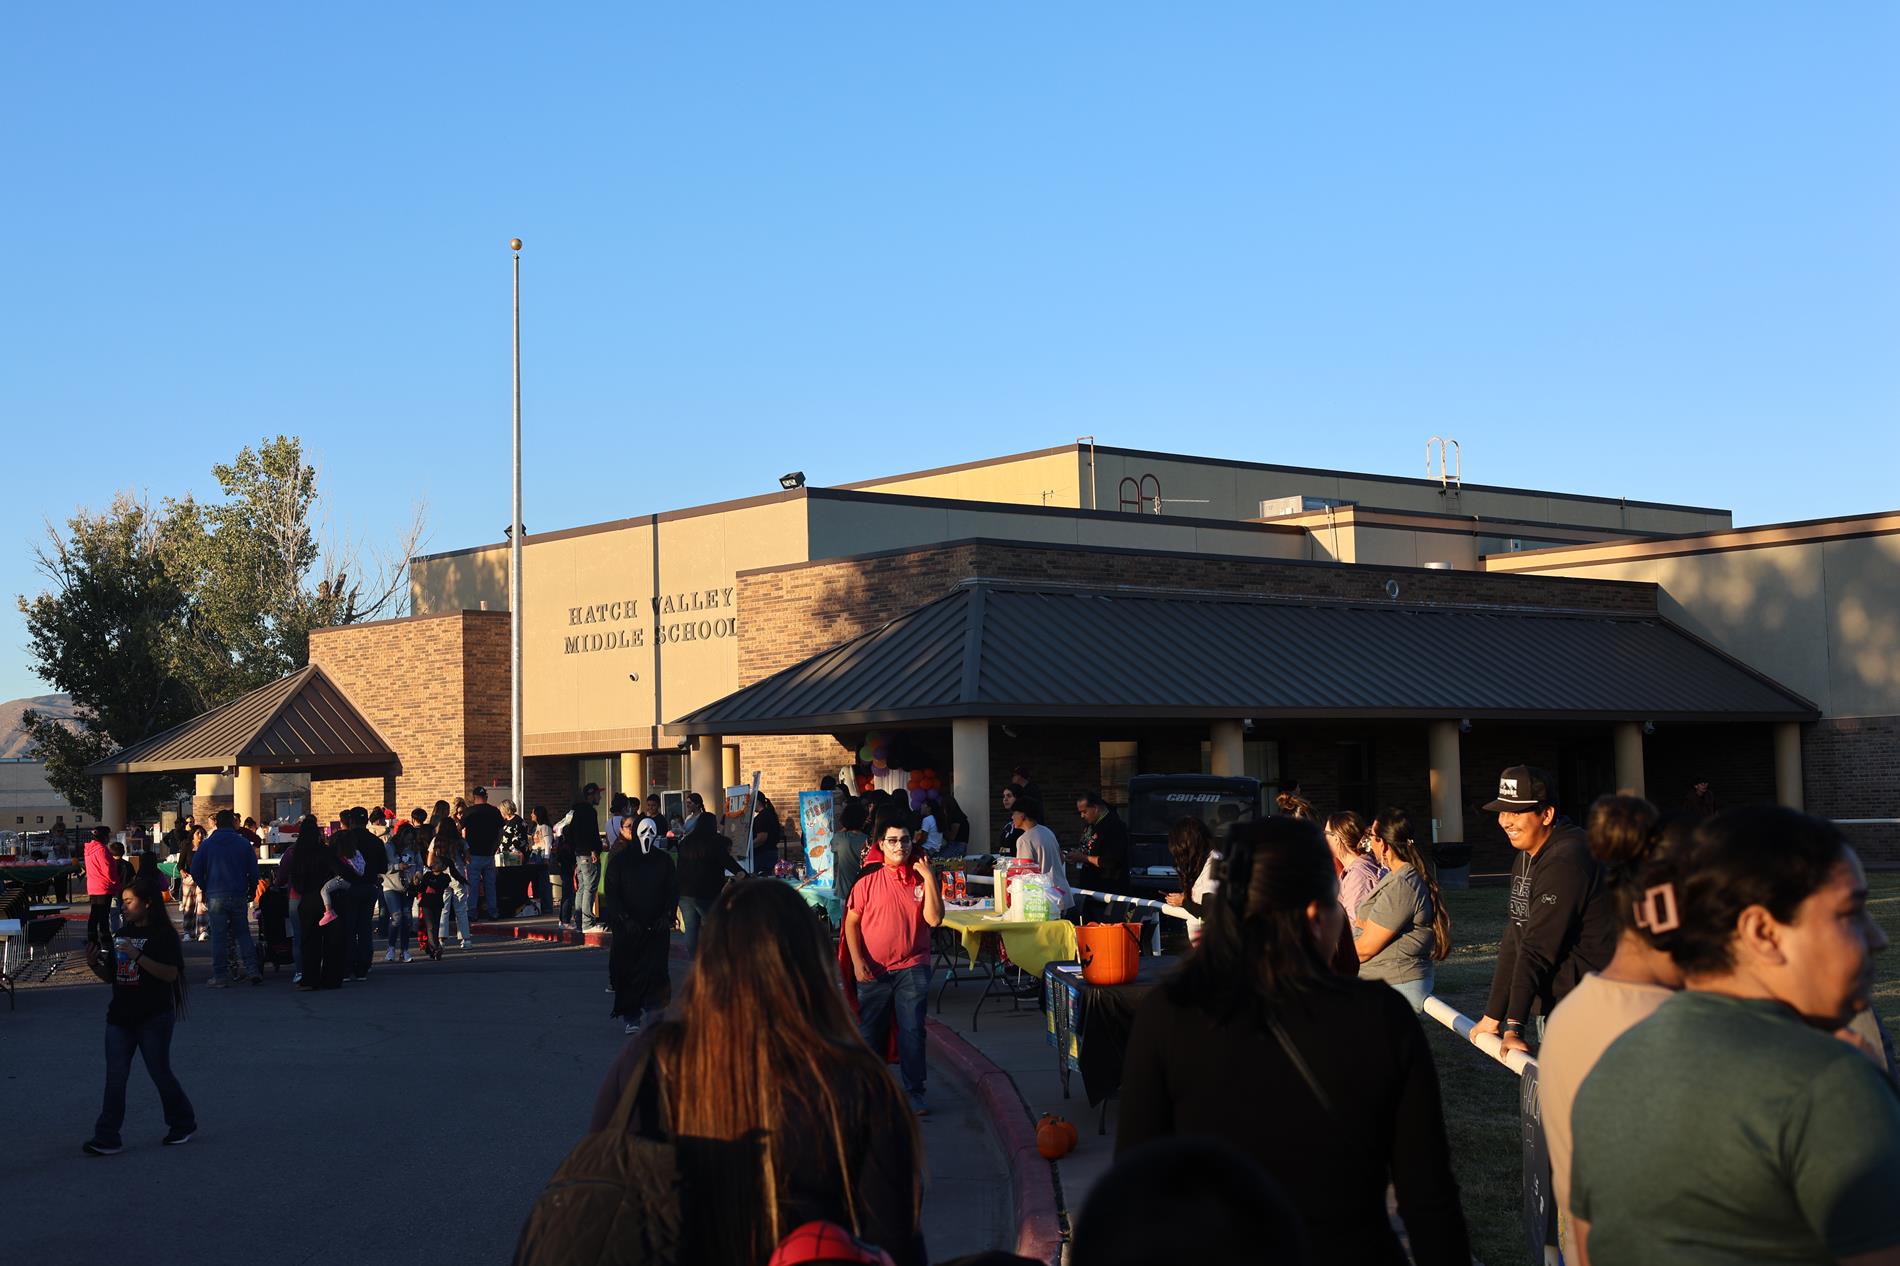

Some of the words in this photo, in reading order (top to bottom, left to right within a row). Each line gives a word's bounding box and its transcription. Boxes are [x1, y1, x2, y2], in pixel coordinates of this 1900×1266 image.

[568, 600, 638, 626] HATCH
[650, 587, 734, 615] VALLEY
[563, 627, 644, 654] MIDDLE
[654, 617, 738, 645] SCHOOL
